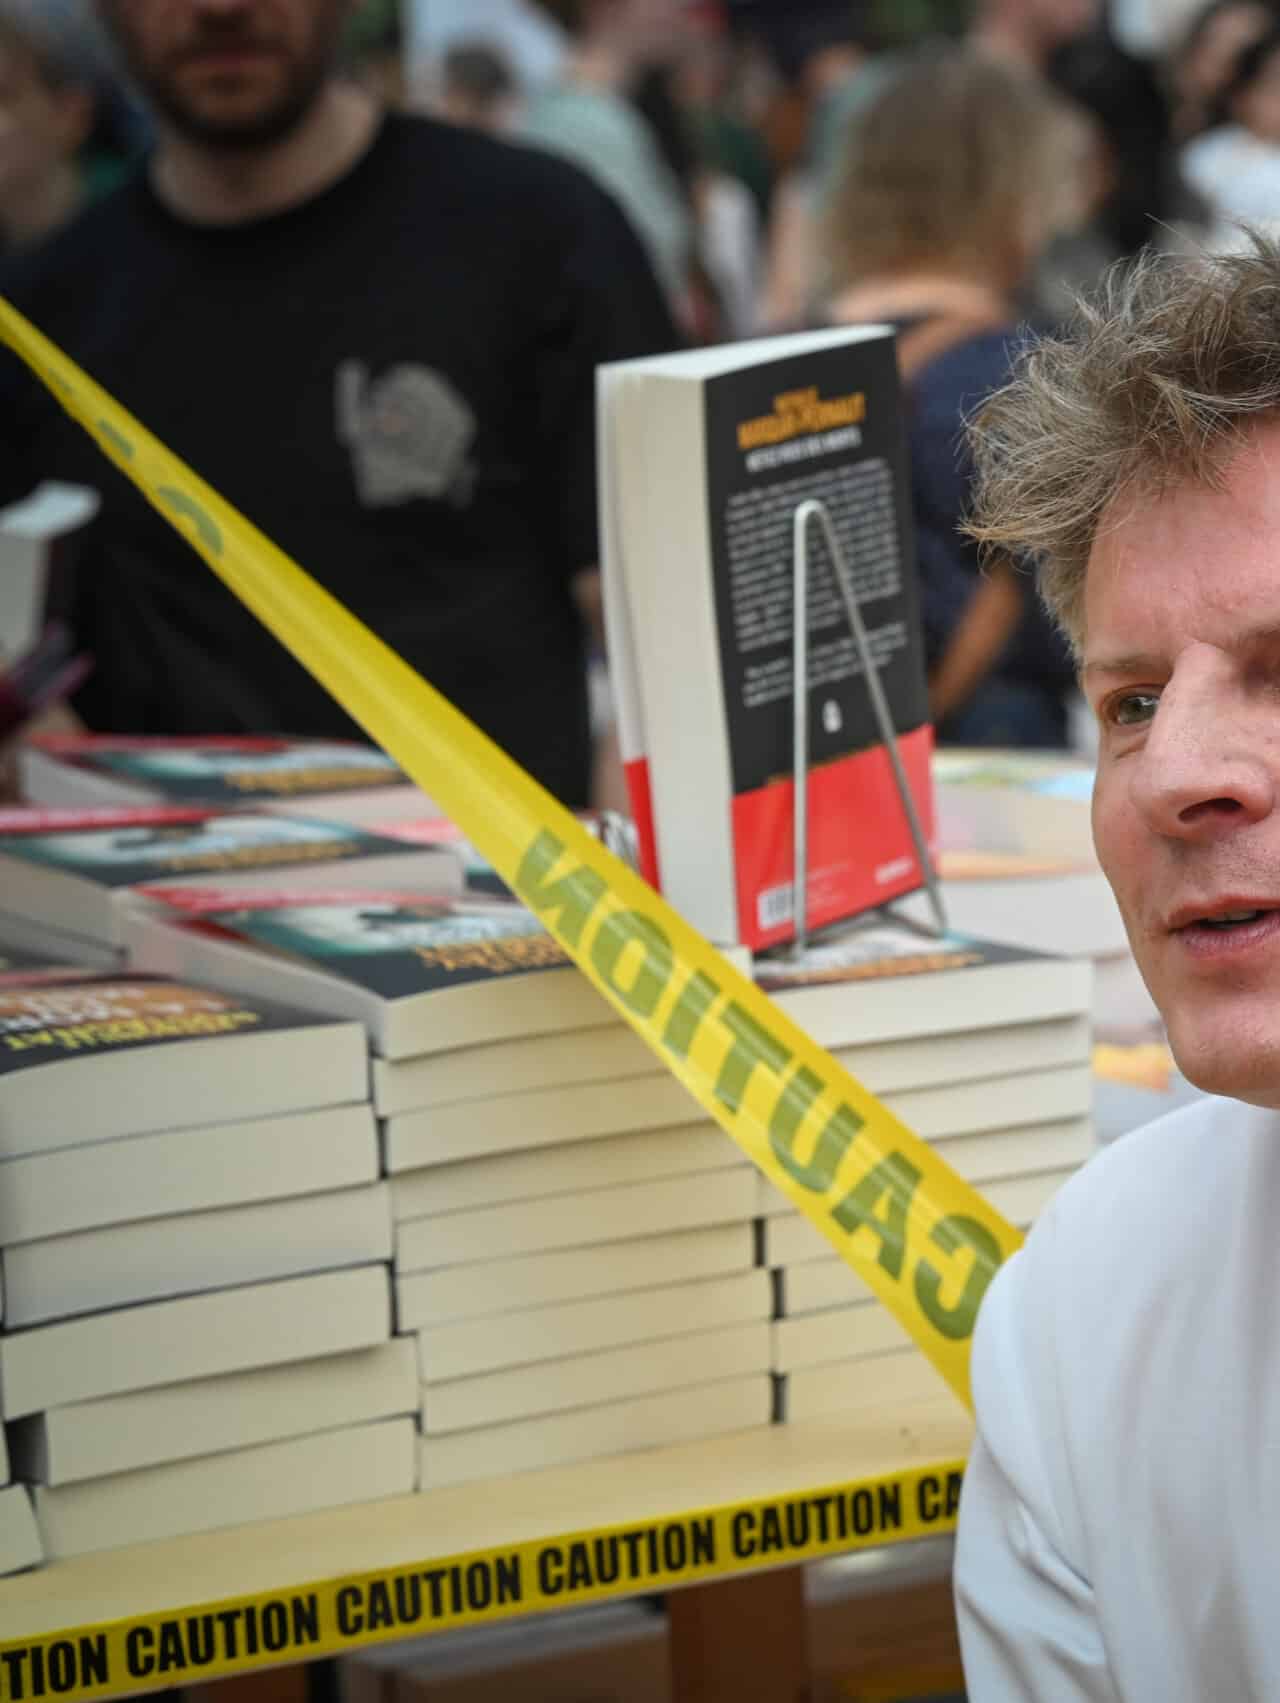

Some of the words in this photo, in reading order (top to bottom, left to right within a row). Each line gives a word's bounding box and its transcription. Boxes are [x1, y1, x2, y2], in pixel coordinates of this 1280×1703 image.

[125, 1593, 320, 1679] CAUTION
[335, 1555, 522, 1637] CAUTION
[538, 1518, 716, 1596] CAUTION
[731, 1484, 902, 1559] CAUTION
